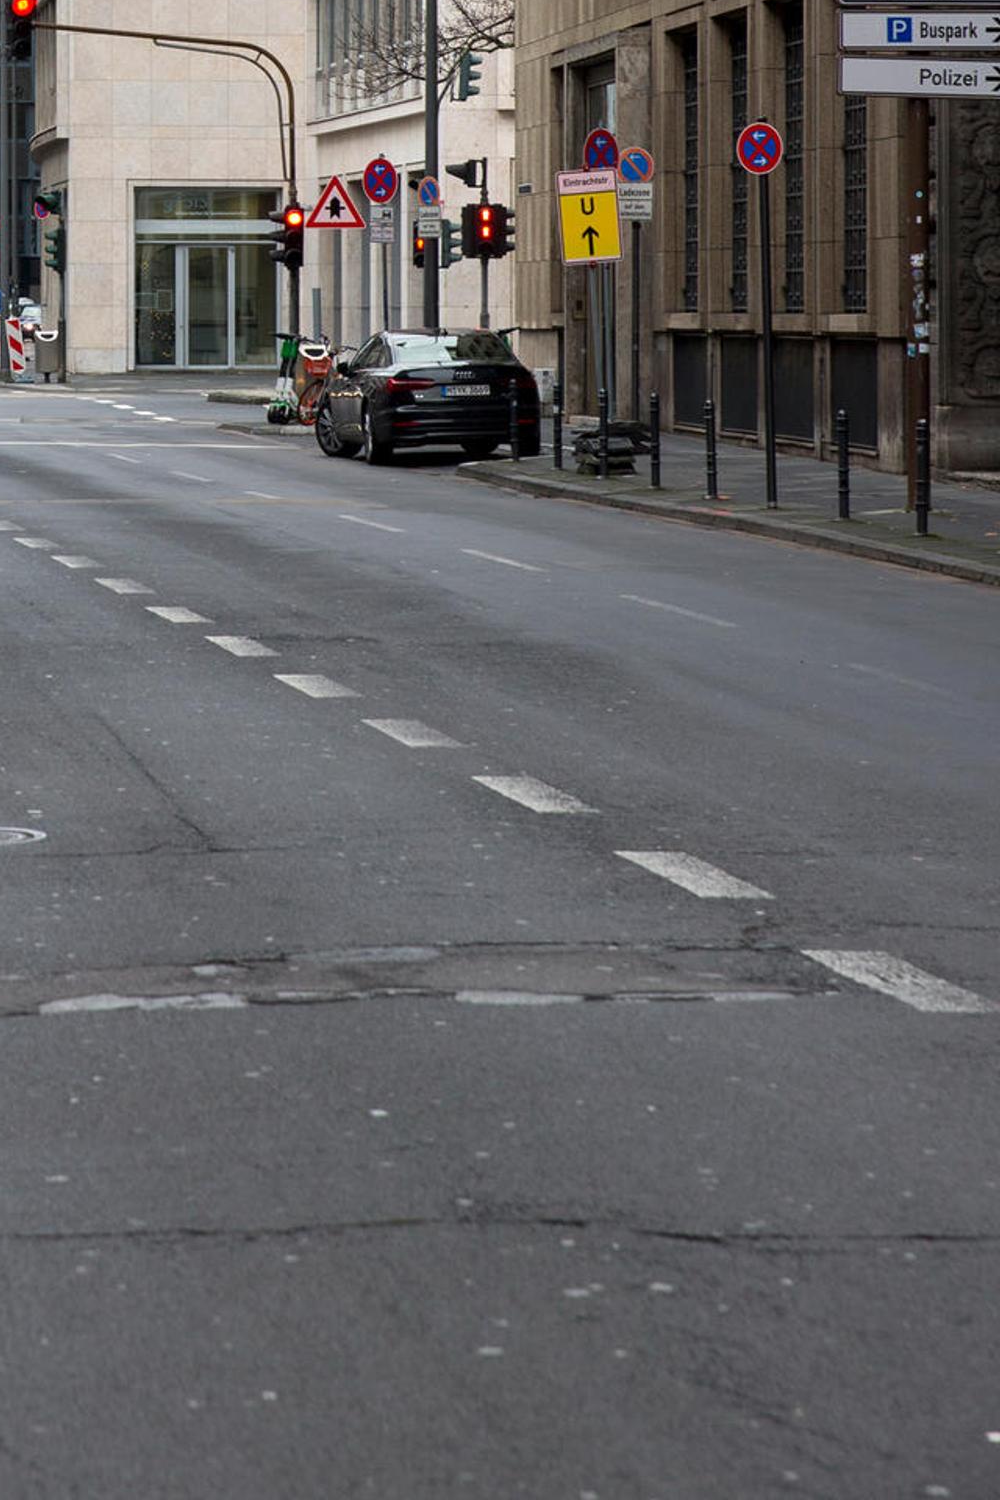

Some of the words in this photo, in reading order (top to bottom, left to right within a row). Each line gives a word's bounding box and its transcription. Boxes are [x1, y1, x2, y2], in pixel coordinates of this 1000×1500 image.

[920, 21, 978, 43] Buspark
[919, 68, 978, 87] Polizei
[580, 197, 595, 215] U
